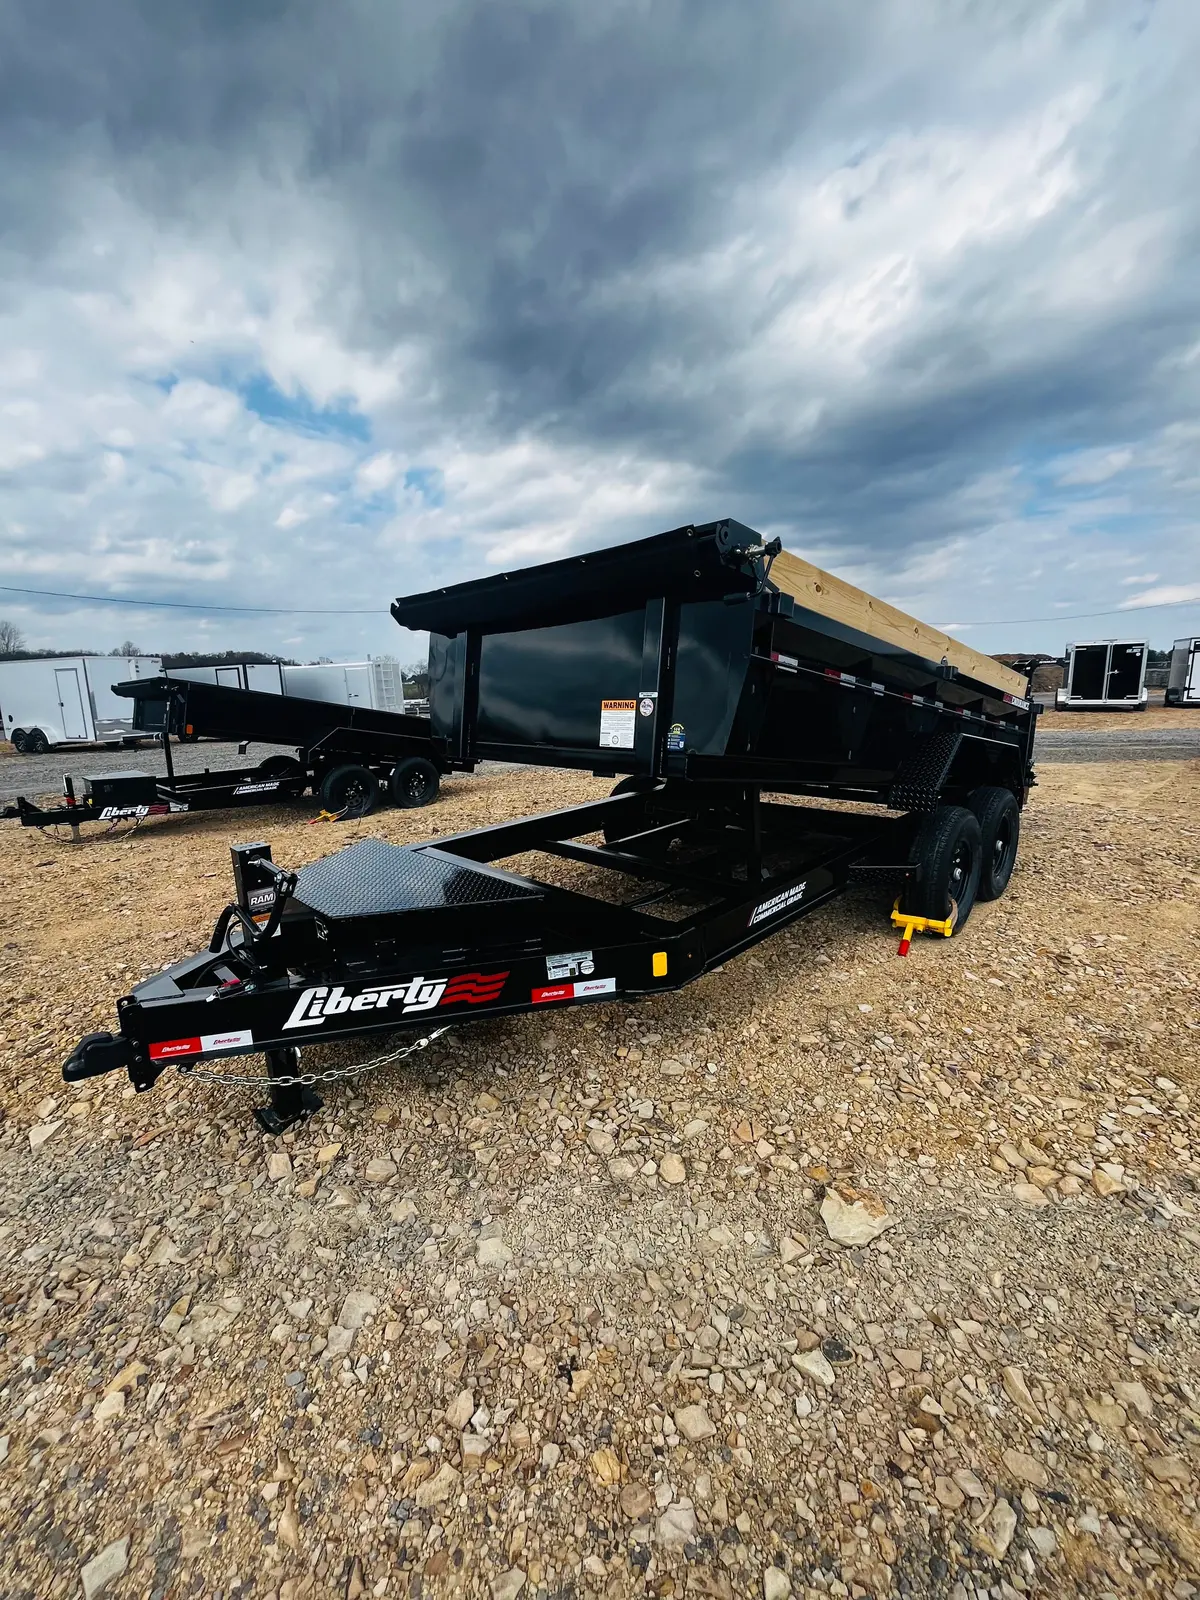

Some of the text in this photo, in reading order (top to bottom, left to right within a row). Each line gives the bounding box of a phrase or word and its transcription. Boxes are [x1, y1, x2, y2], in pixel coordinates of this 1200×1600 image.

[603, 701, 635, 709] WARNING
[98, 804, 150, 820] Liberty
[250, 892, 274, 906] RAM
[753, 891, 804, 924] COMMERCIAL GRADE
[756, 881, 807, 914] AMERICAN MADE
[281, 976, 449, 1031] Liberty
